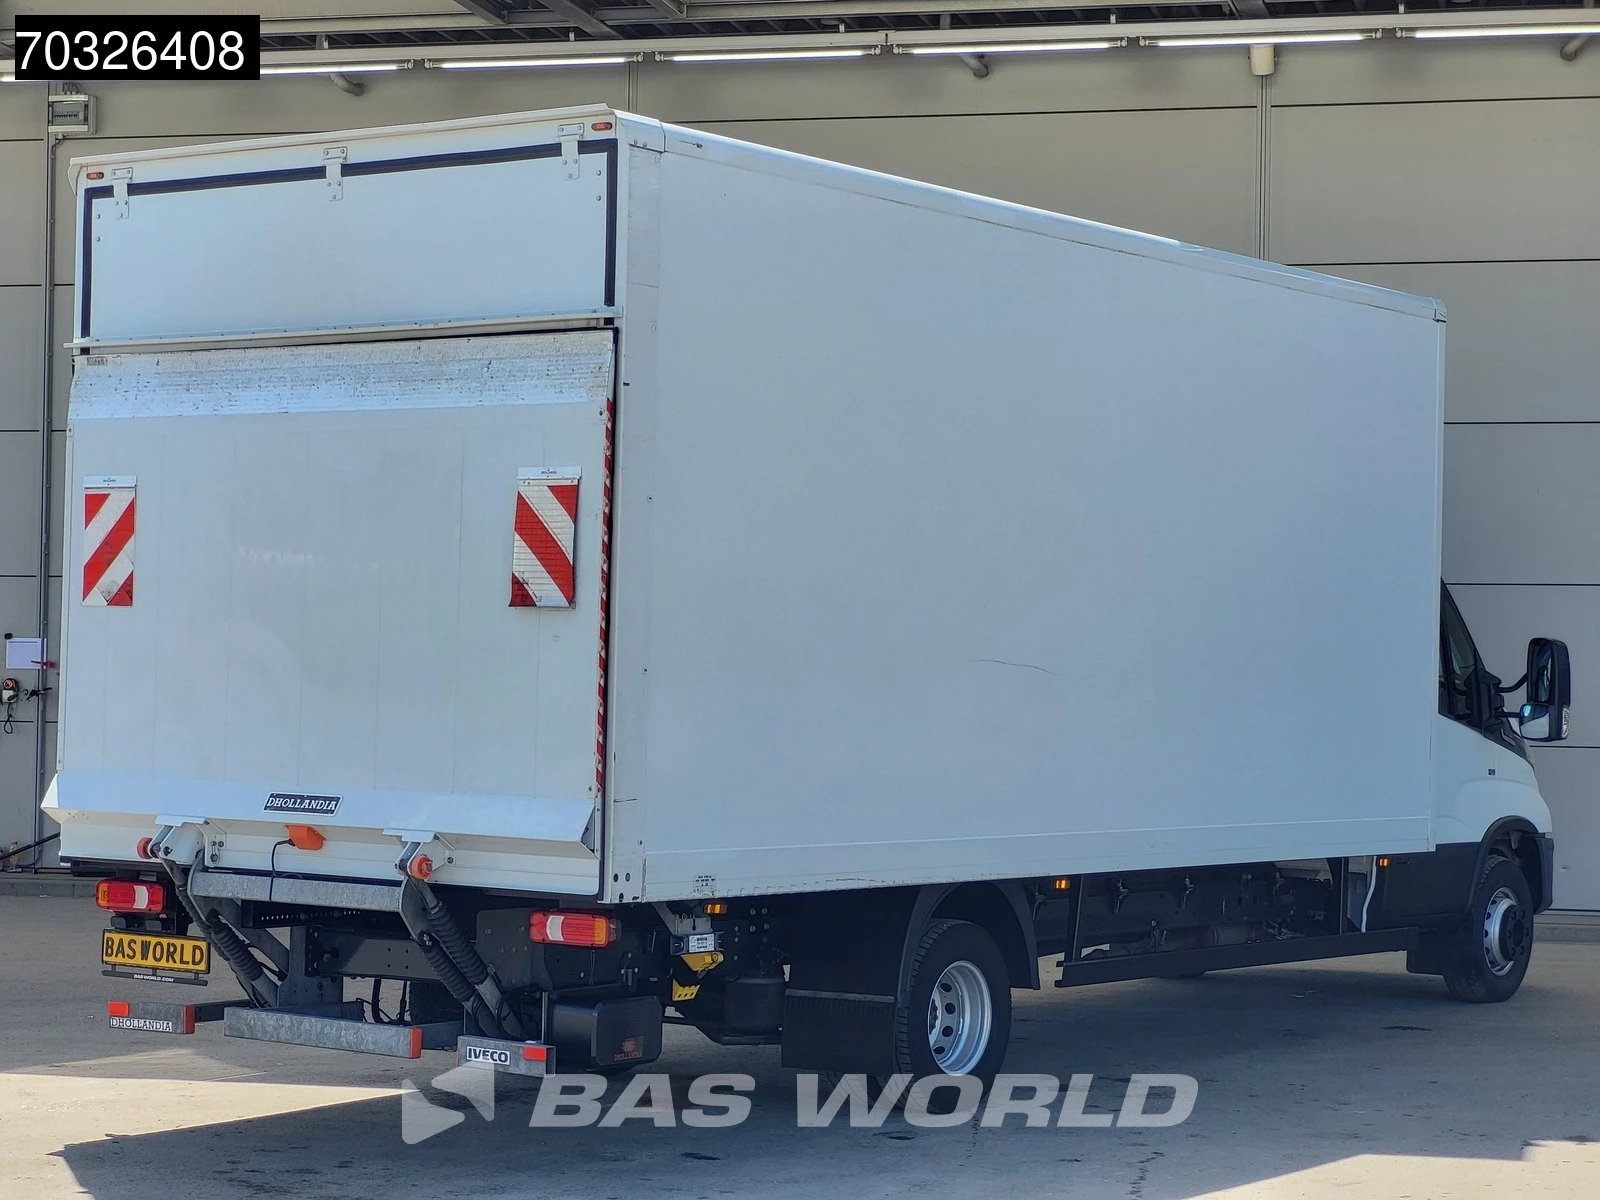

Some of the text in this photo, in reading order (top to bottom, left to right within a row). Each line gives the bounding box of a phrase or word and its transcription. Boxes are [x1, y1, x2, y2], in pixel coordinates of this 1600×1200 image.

[267, 798, 337, 810] DHOLLANDIA
[105, 936, 204, 965] BAS WORLD
[110, 1017, 172, 1031] DHOLLANDIA
[467, 1048, 509, 1063] IVECO
